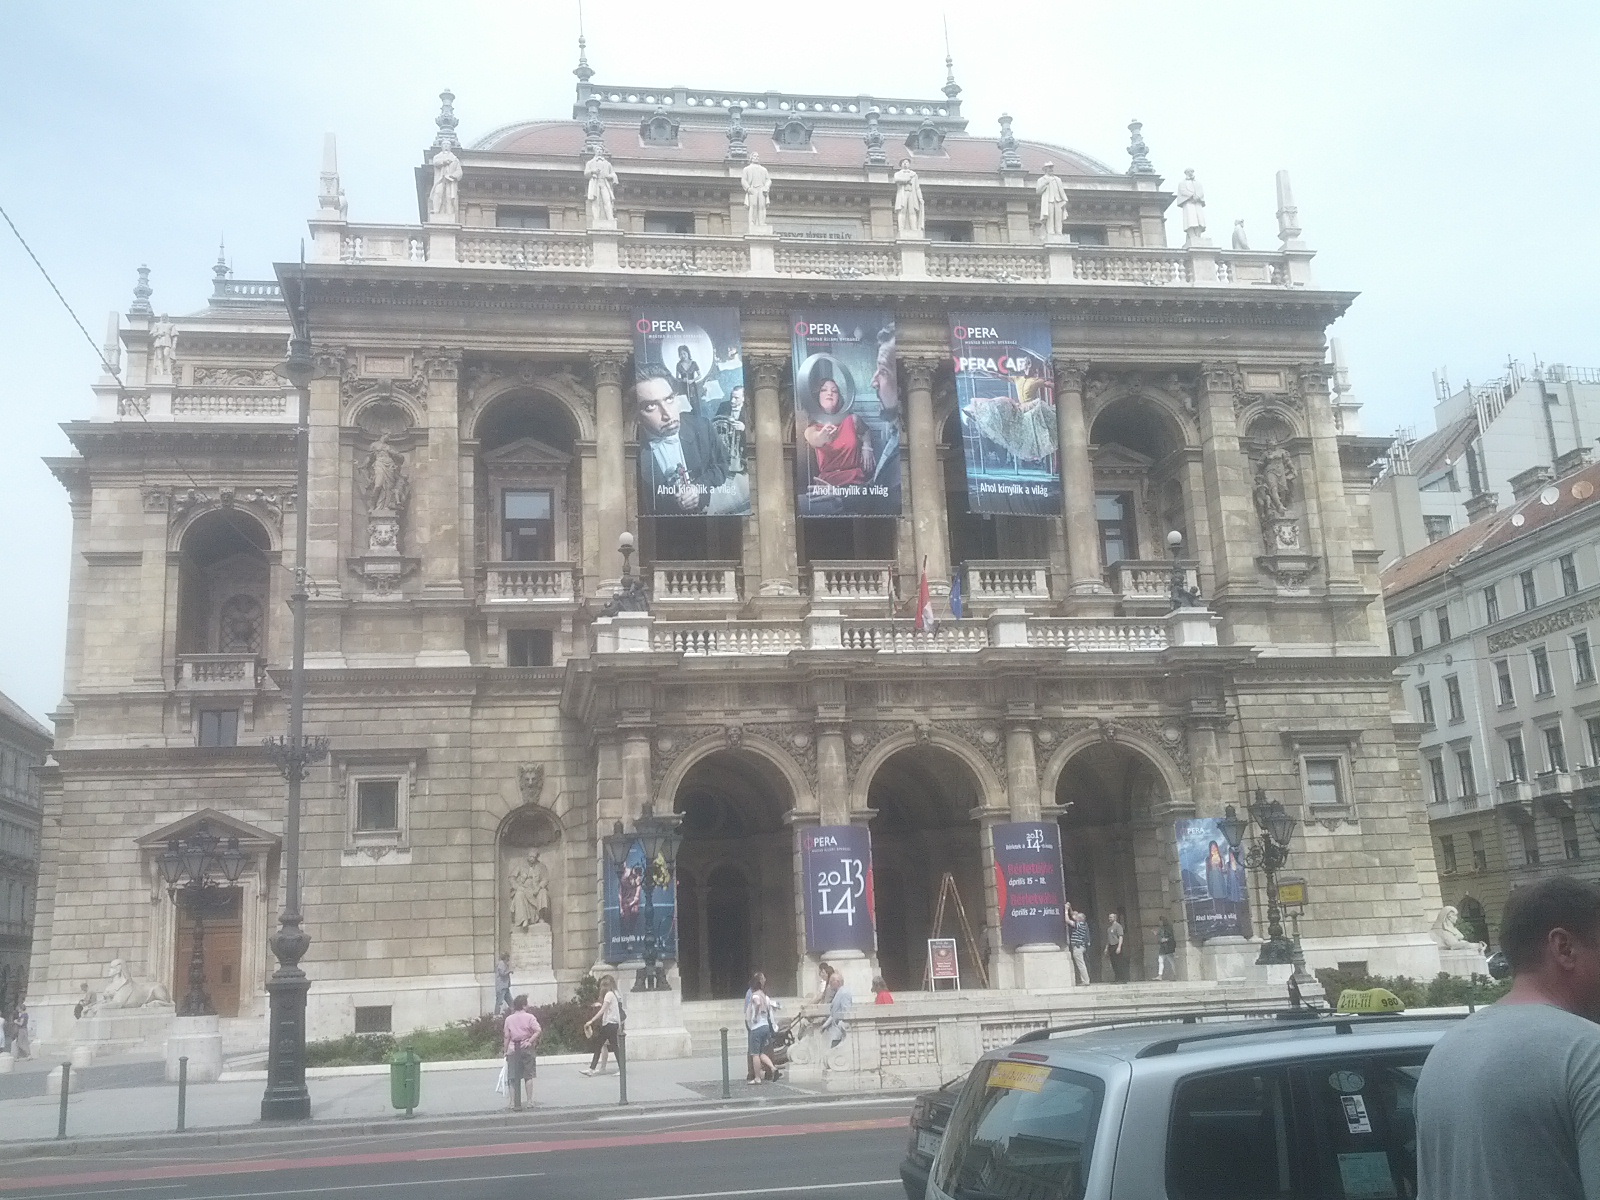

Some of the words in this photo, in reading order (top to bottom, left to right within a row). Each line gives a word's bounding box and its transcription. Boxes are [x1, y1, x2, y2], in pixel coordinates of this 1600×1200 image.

[636, 319, 685, 333] OPERA
[795, 321, 841, 336] OPERA
[953, 325, 999, 340] OPERA
[657, 484, 676, 495] Ahol
[812, 485, 831, 496] Ahol
[862, 487, 868, 496] a
[869, 484, 889, 498] világ
[980, 483, 997, 493] Ahol
[1025, 486, 1030, 495] a
[1031, 484, 1049, 498] világ
